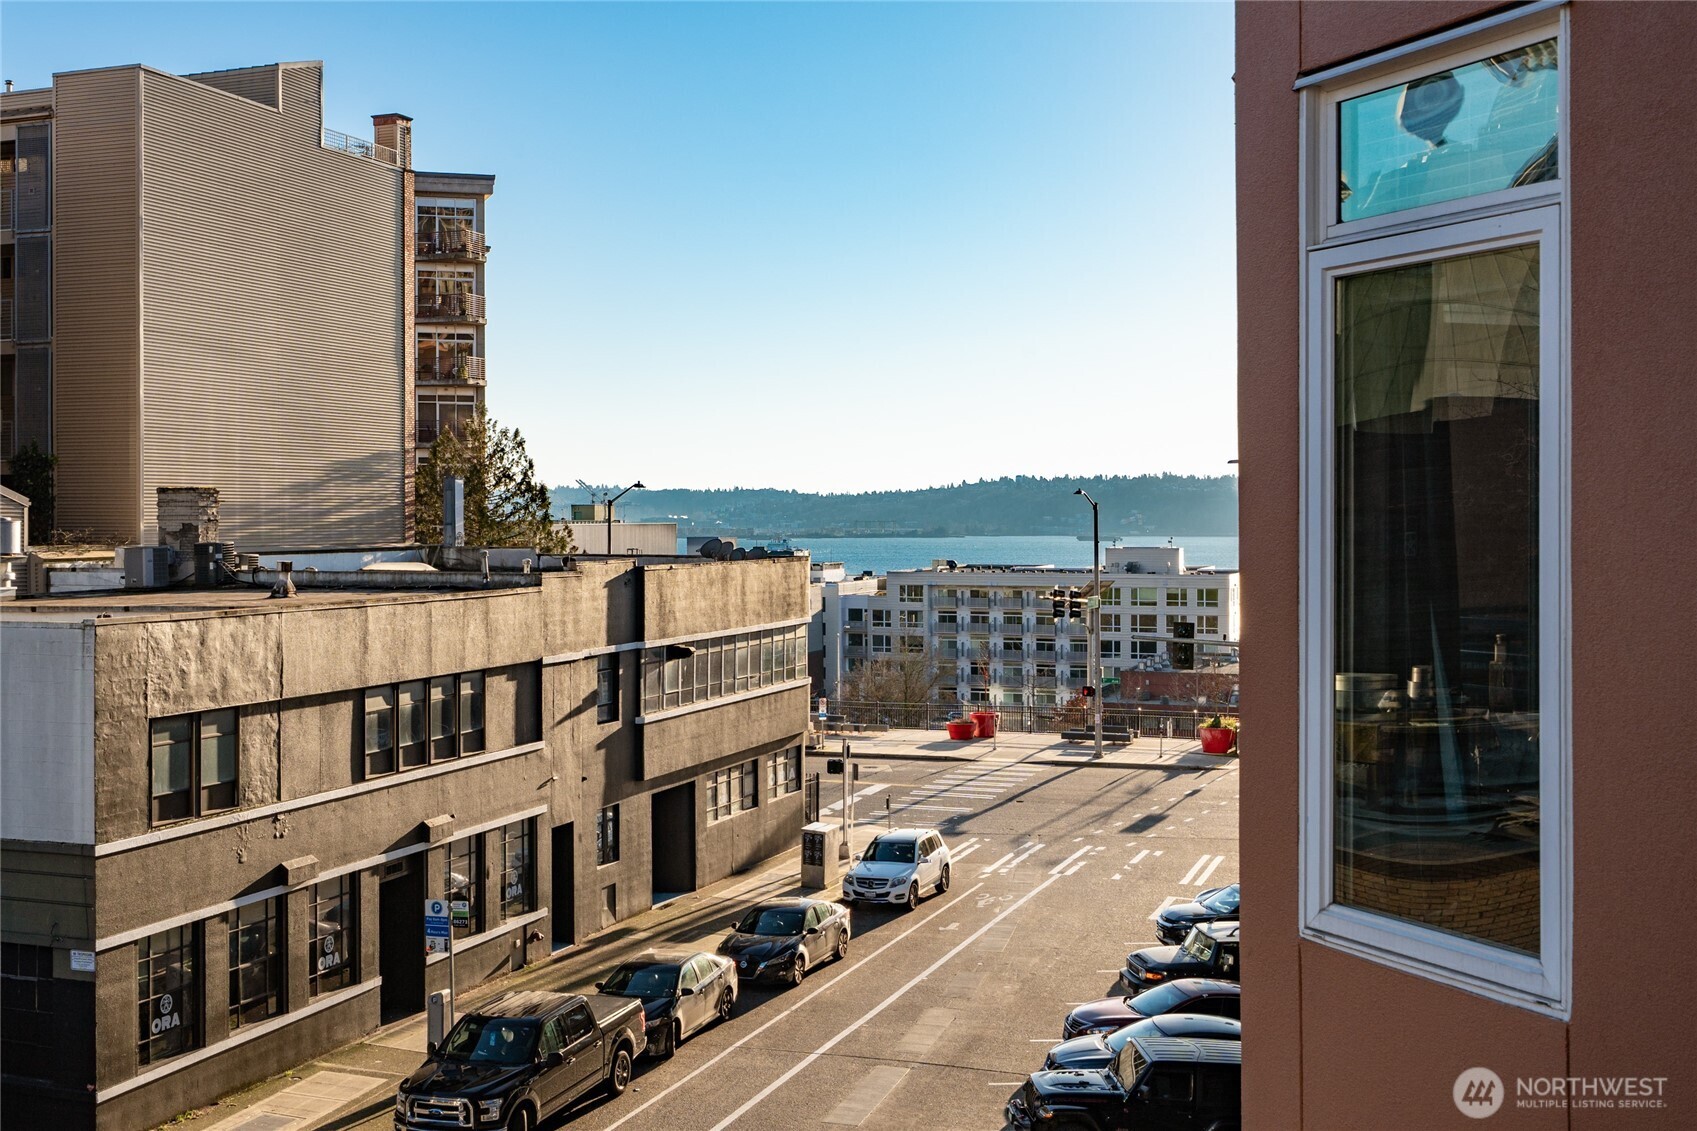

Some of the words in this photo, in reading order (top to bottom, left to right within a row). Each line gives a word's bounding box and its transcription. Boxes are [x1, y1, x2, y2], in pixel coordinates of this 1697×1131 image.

[506, 883, 522, 899] ORA
[434, 903, 441, 913] P
[317, 951, 341, 971] ORA
[151, 1012, 181, 1034] ORA
